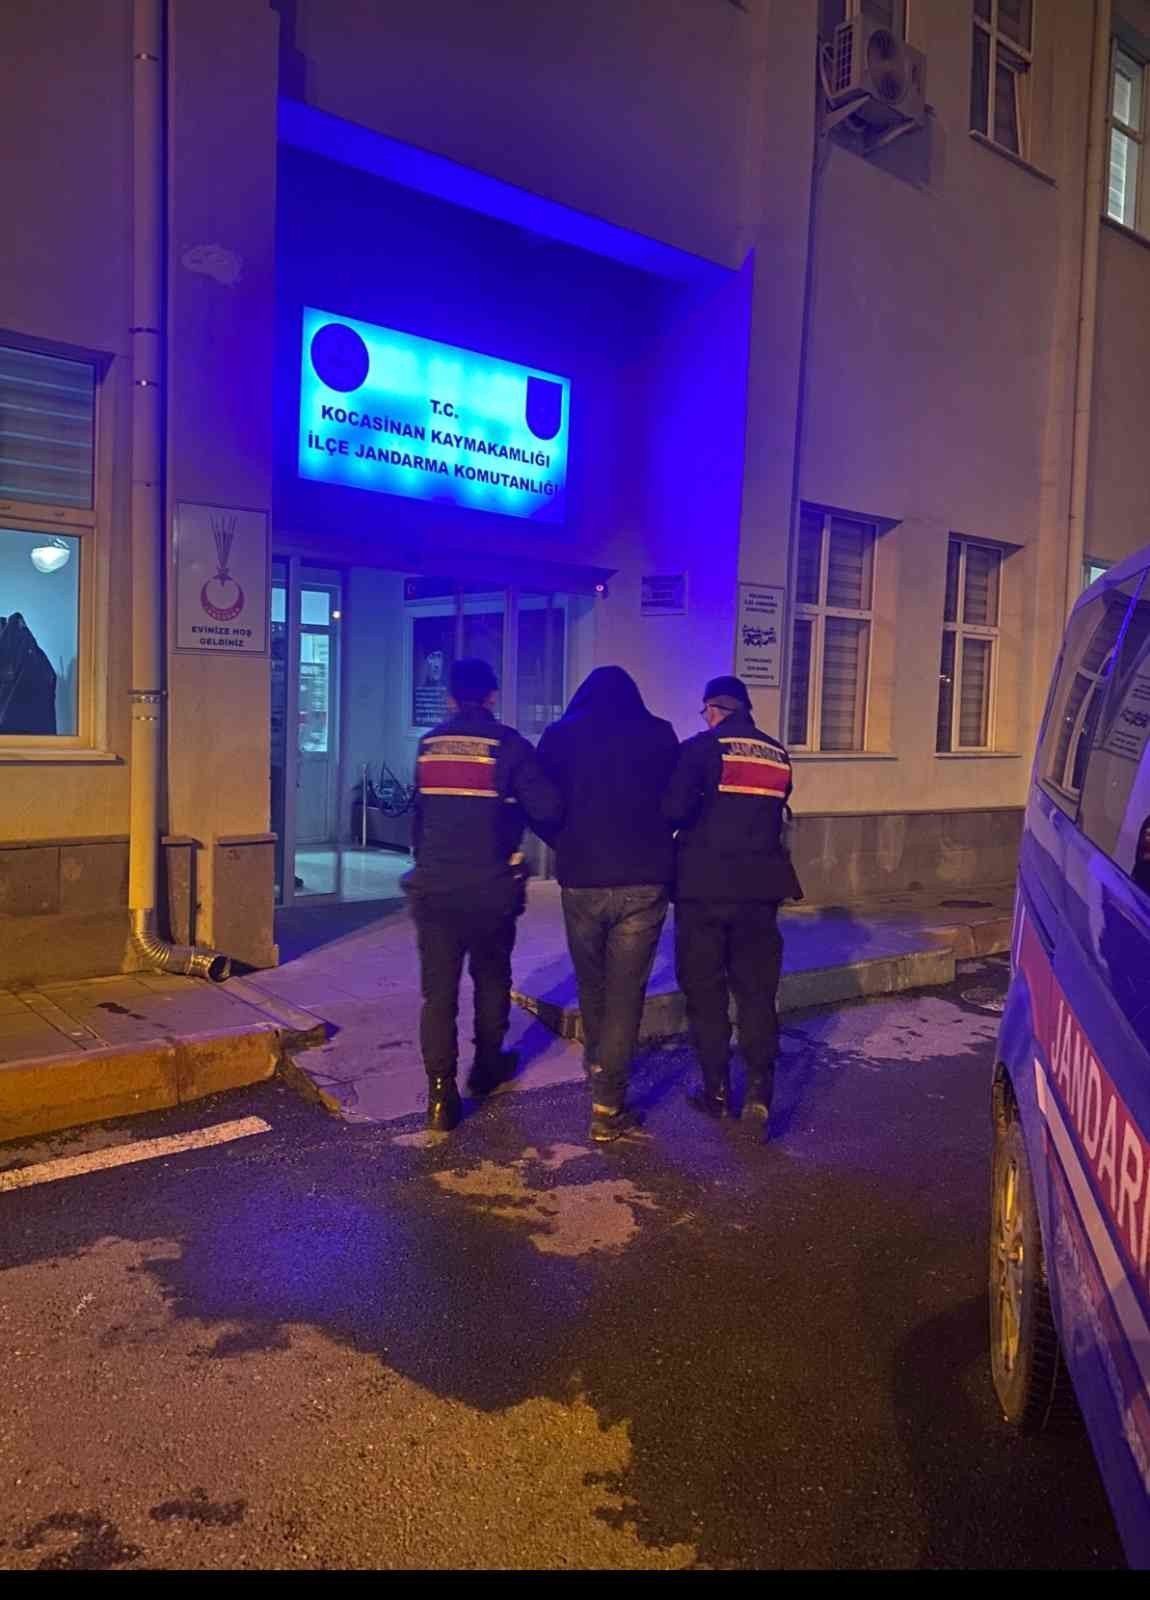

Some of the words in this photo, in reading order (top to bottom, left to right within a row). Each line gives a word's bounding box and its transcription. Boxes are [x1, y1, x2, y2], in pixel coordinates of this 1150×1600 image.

[321, 404, 426, 441] KOCASİNAN
[431, 429, 550, 469] KAYMAKAMLIĞI
[430, 398, 459, 419] T.C.
[308, 430, 349, 457] İLÇE
[355, 443, 450, 476] JANDARMA
[453, 463, 560, 496] KOMUTANLIĞI
